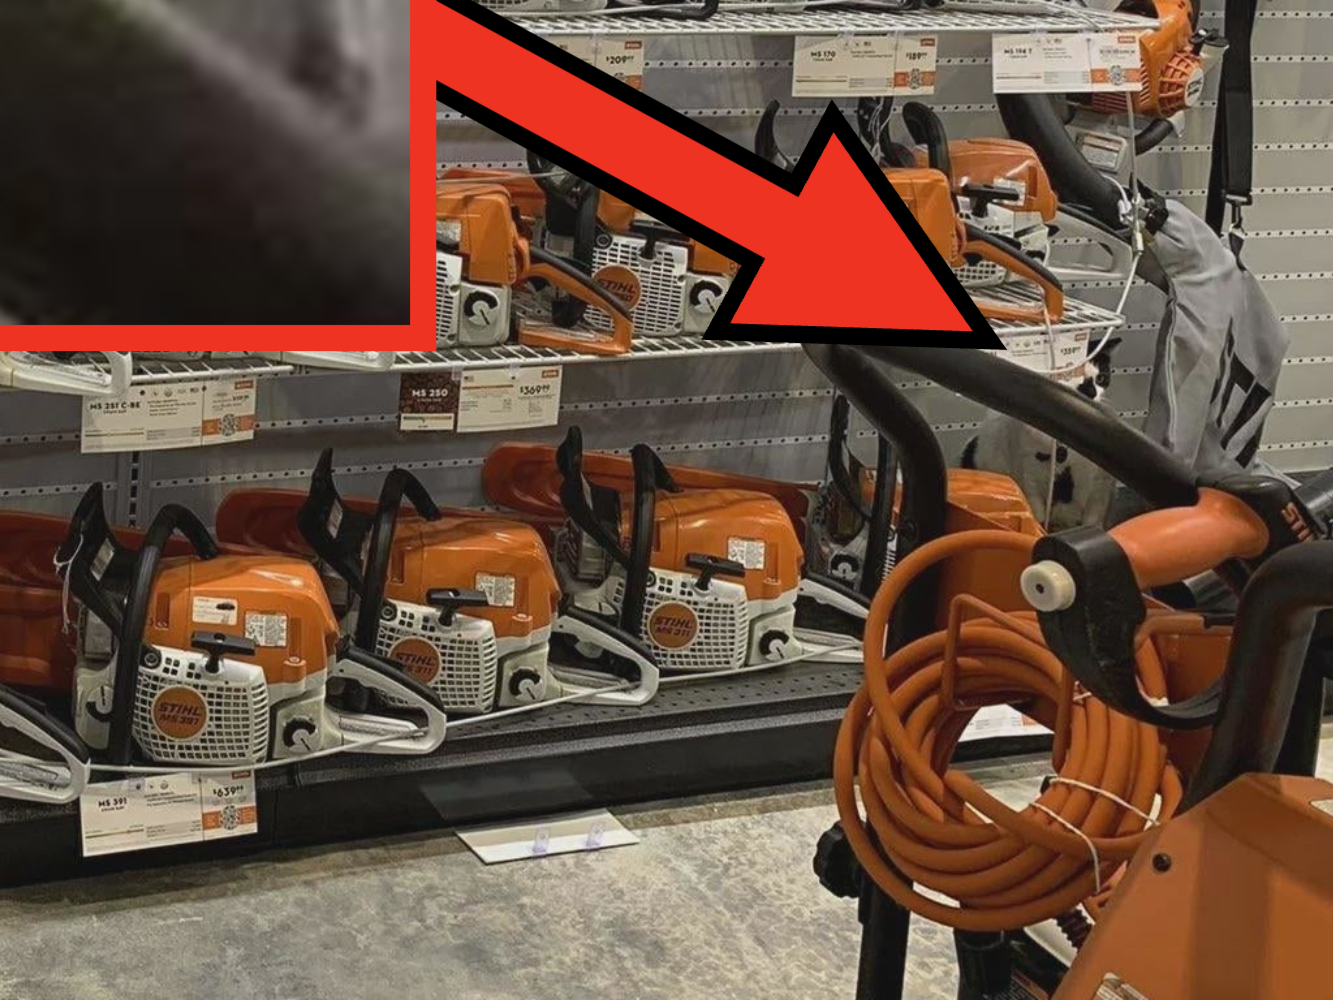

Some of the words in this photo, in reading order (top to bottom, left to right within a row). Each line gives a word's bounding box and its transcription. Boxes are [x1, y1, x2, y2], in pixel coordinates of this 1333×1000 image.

[429, 389, 448, 397] 250
[90, 402, 102, 410] MS
[104, 401, 119, 410] 251
[655, 616, 693, 629] STIHL
[395, 652, 436, 667] STIHL
[159, 702, 201, 716] STIHL
[98, 799, 111, 807] MS
